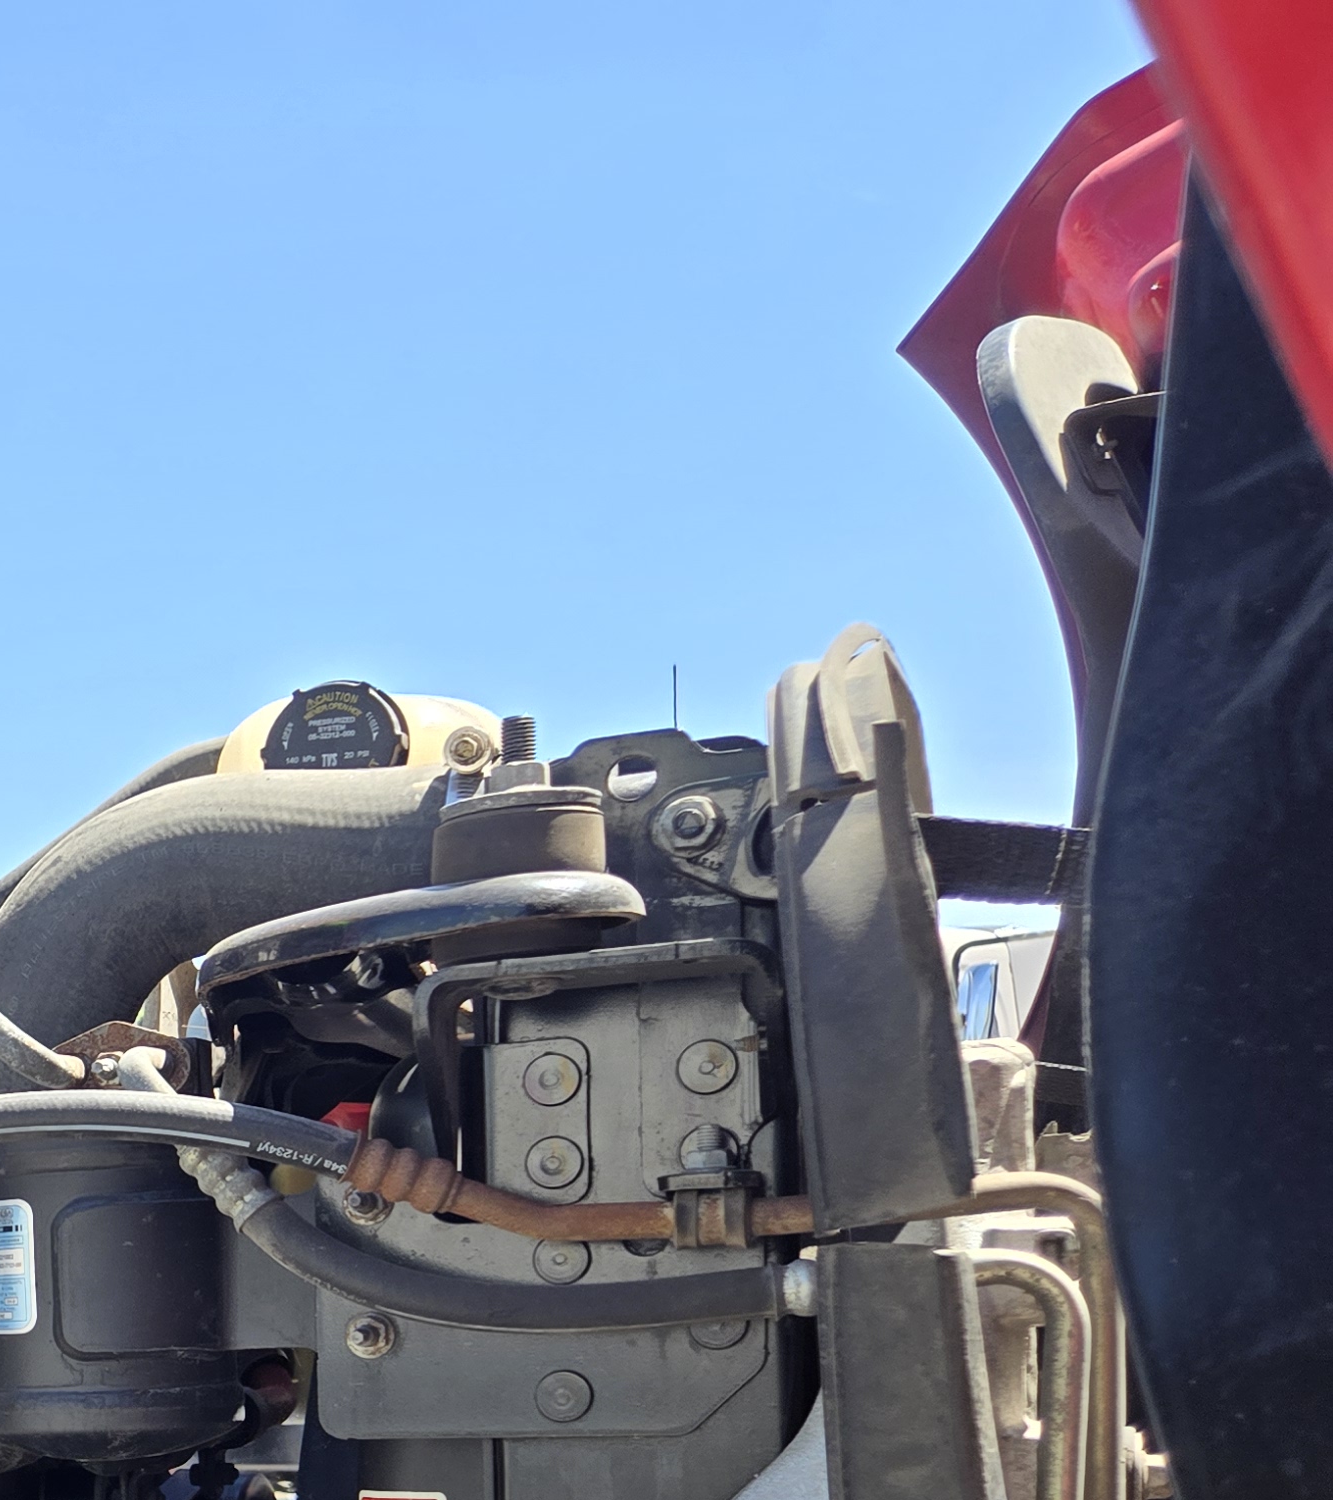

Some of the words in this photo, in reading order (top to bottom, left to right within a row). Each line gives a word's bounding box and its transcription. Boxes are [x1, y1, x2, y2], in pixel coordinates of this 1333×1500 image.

[315, 692, 359, 707] CAUTION
[344, 751, 355, 760] 20
[357, 750, 370, 758] PSI
[257, 1142, 317, 1165] R-1234yf
